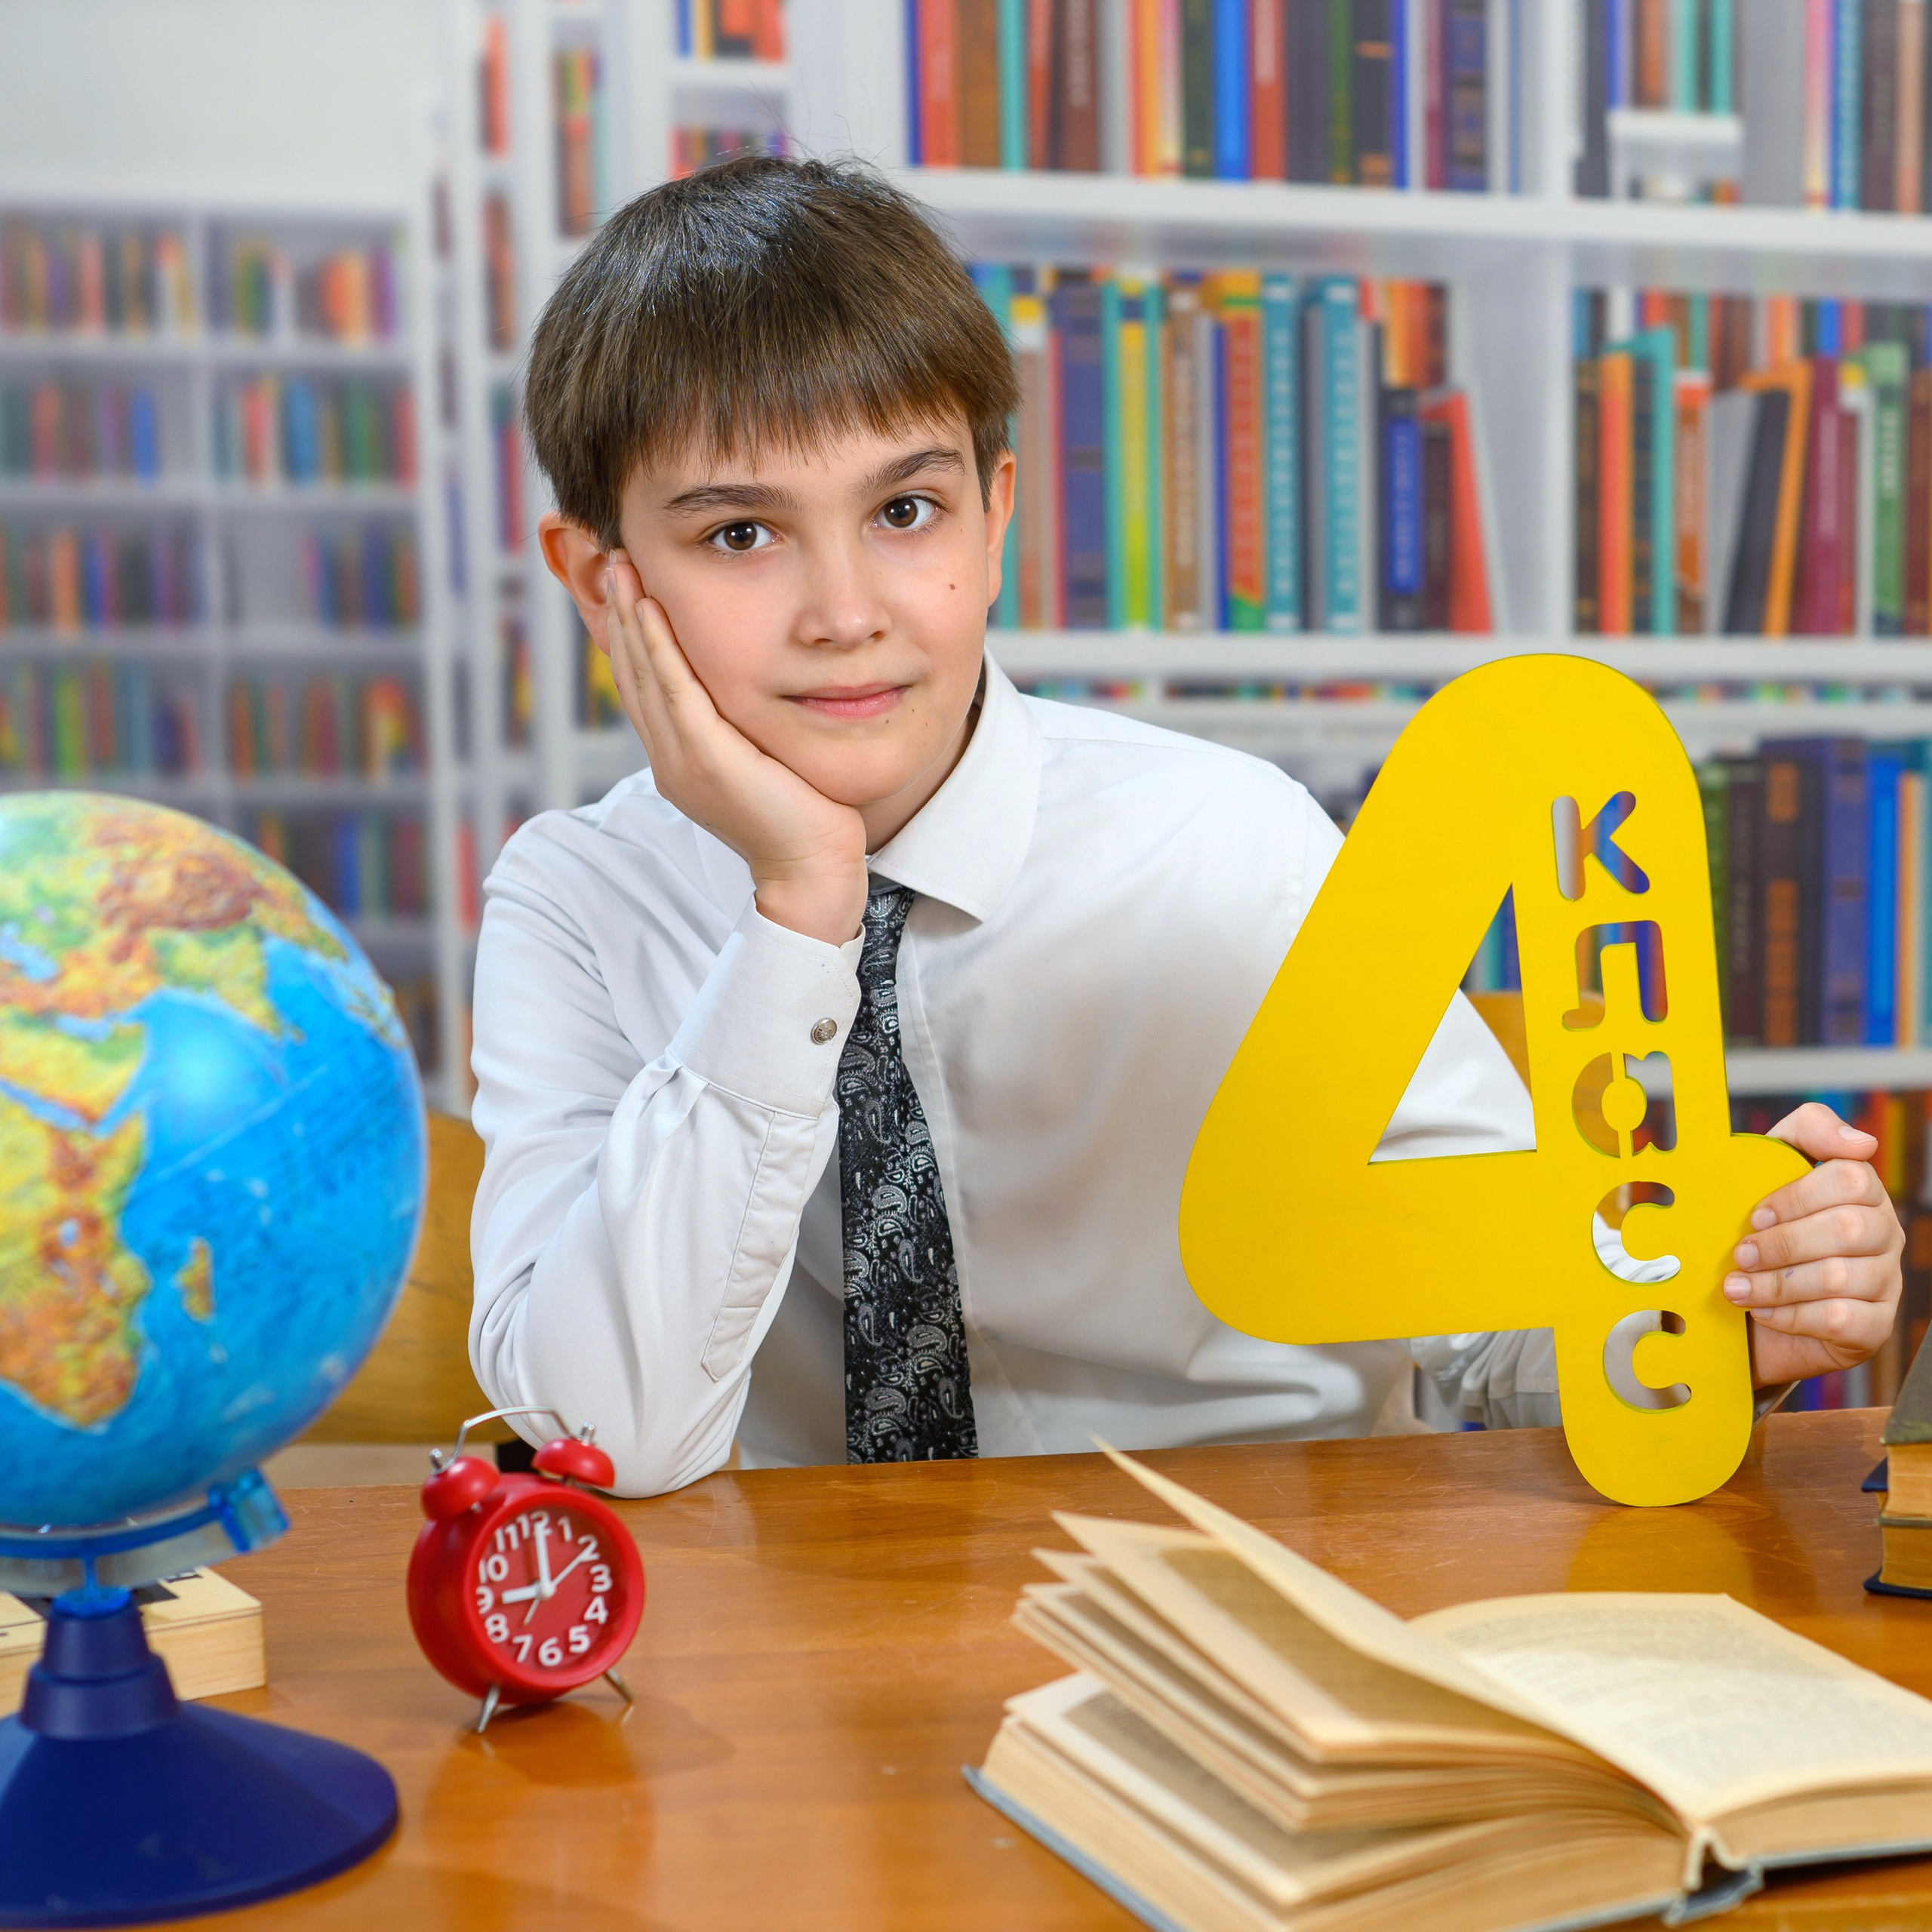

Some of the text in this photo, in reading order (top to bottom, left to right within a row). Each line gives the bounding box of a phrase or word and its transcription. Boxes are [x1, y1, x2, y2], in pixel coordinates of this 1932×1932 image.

[1179, 654, 1813, 1506] 4
[494, 1524, 519, 1552] 11
[516, 1511, 552, 1540] 12
[558, 1516, 572, 1542] 1
[577, 1534, 600, 1562] 2
[478, 1553, 509, 1584] 10
[589, 1564, 612, 1592] 3
[475, 1586, 495, 1615] 9
[583, 1595, 608, 1624] 4
[485, 1613, 510, 1644] 8
[568, 1625, 591, 1654] 5
[512, 1634, 533, 1663] 7
[538, 1637, 563, 1666] 6
